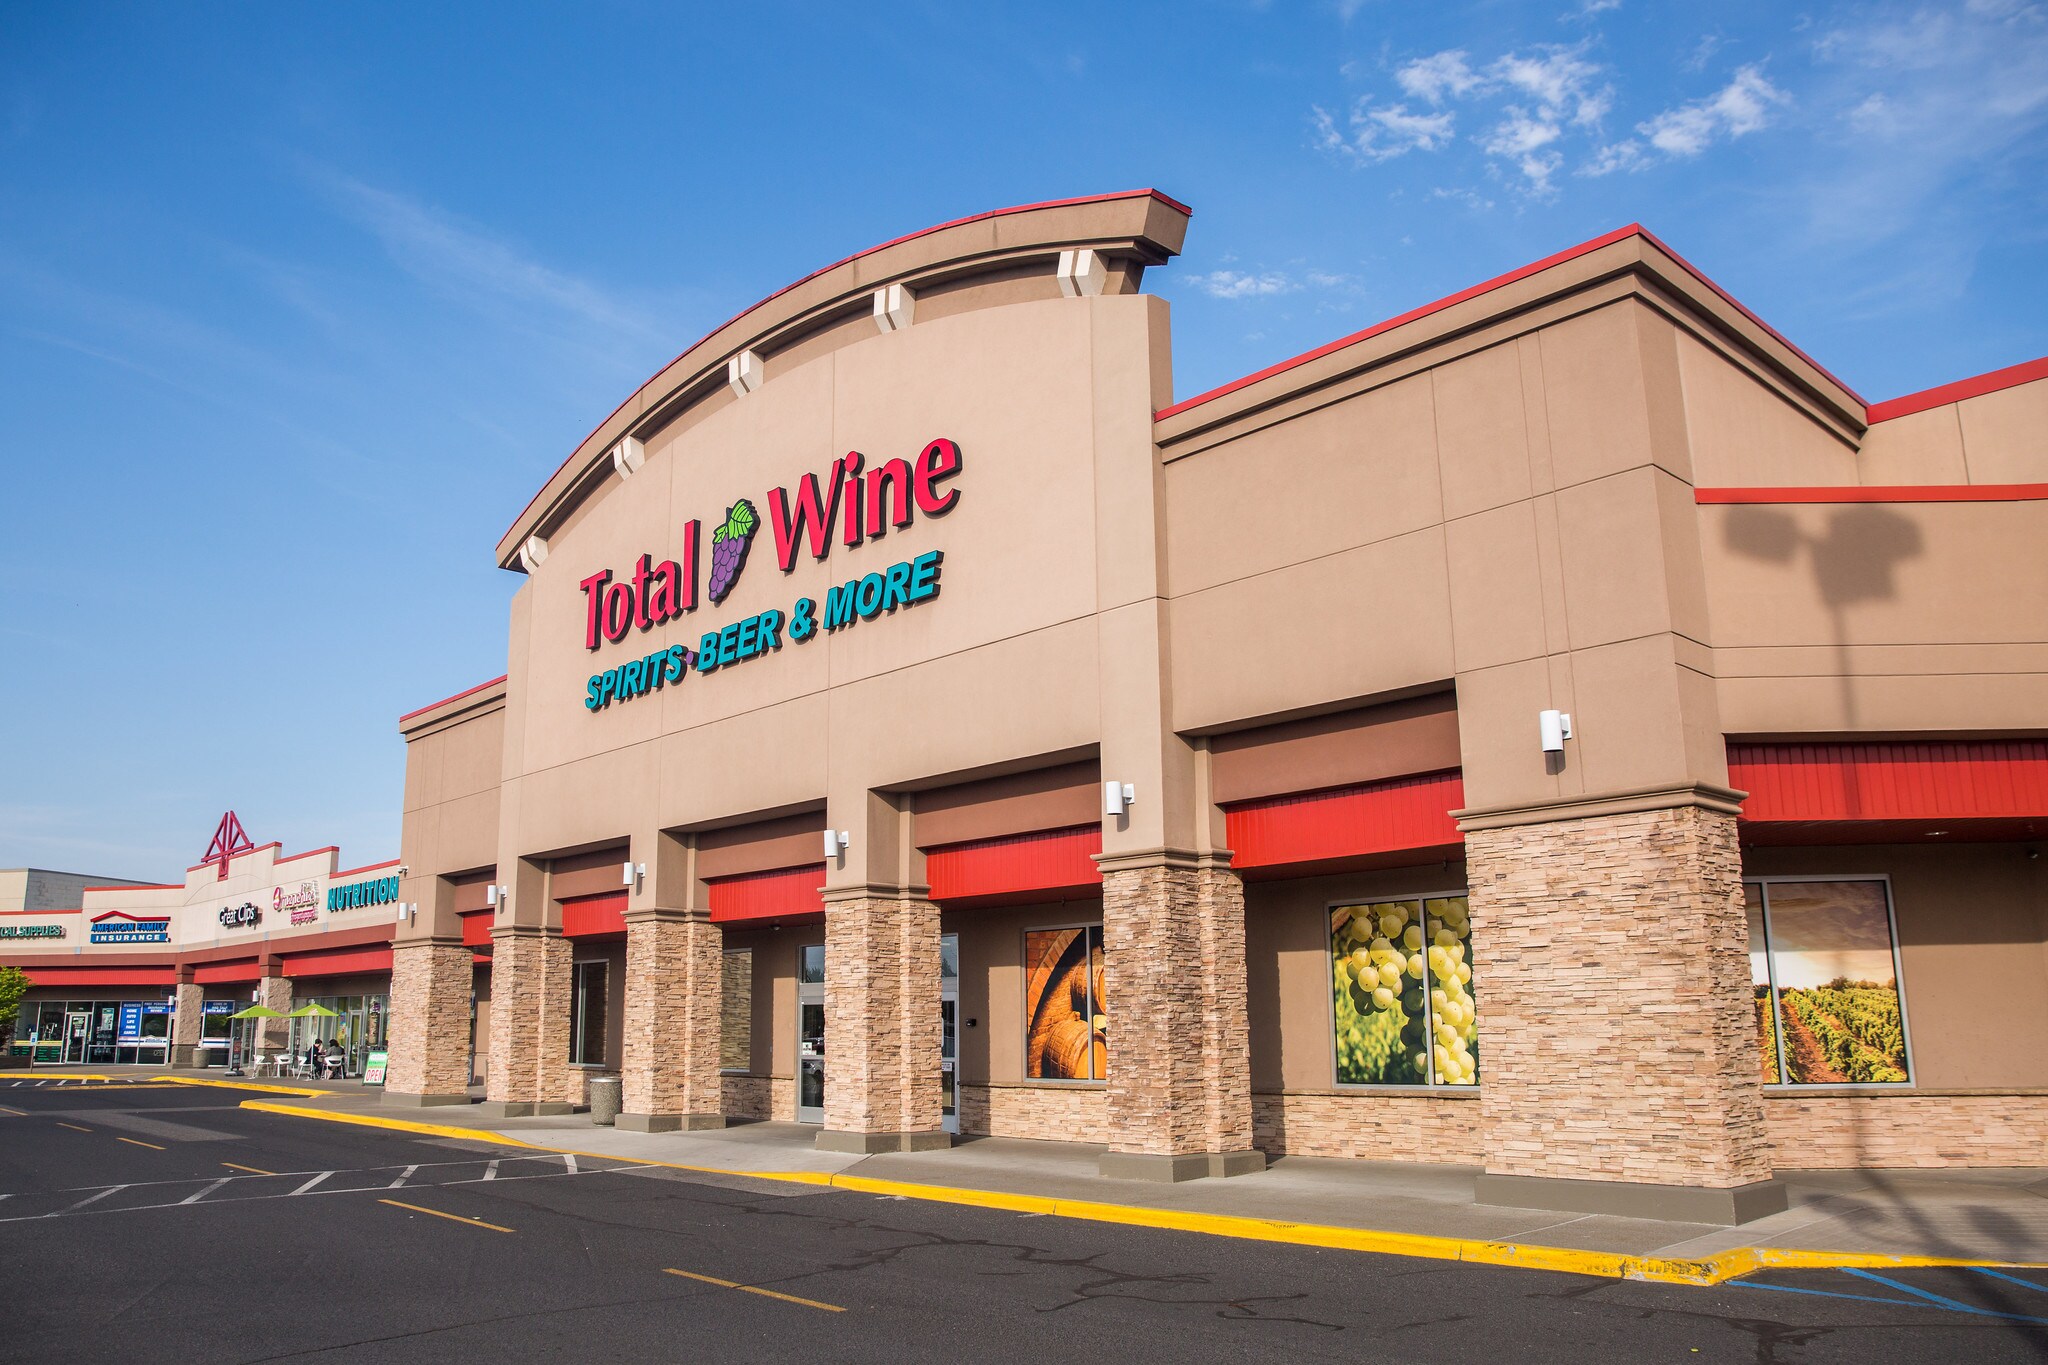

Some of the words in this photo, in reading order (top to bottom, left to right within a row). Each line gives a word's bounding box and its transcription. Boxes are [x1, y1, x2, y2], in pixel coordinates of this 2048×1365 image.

[580, 519, 700, 650] Total
[767, 438, 962, 572] Wine
[585, 645, 687, 711] SPIRITS
[698, 609, 785, 672] BEER
[789, 598, 817, 641] &
[823, 550, 944, 632] MORE
[327, 875, 400, 910] NUTRITION
[219, 905, 237, 925] Great
[238, 902, 257, 924] Clips
[18, 925, 62, 937] SUPPLIES
[91, 922, 135, 932] AMERICAN
[136, 922, 168, 932] FAMILY
[95, 934, 160, 942] INSURANCE
[365, 1069, 384, 1081] OPEN
